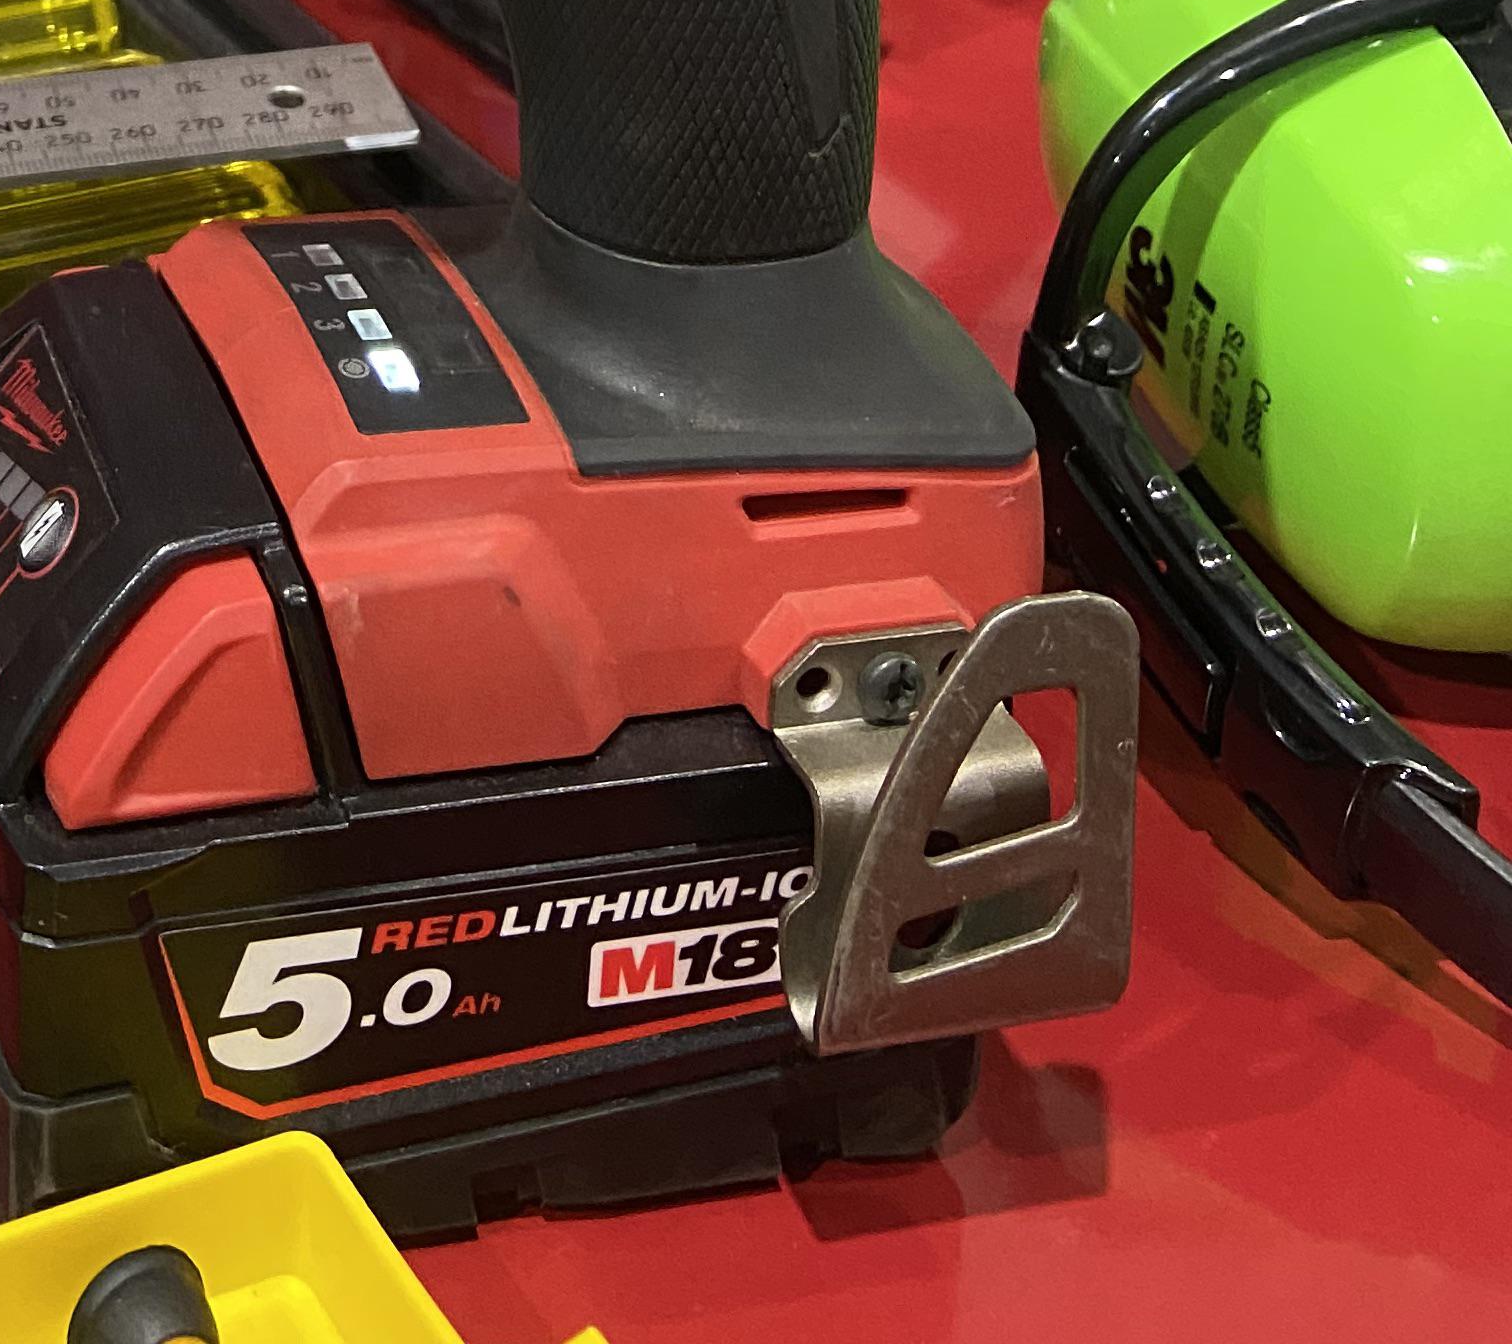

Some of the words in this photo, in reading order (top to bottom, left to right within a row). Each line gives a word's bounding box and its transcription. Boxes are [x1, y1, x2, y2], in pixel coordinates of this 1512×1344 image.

[45, 131, 91, 148] 250
[109, 124, 156, 140] 260
[180, 116, 224, 132] 270
[291, 280, 323, 294] 2
[313, 318, 346, 331] 3
[599, 928, 778, 998] M18
[207, 927, 453, 1072] 5.0
[452, 992, 501, 1018] Ah
